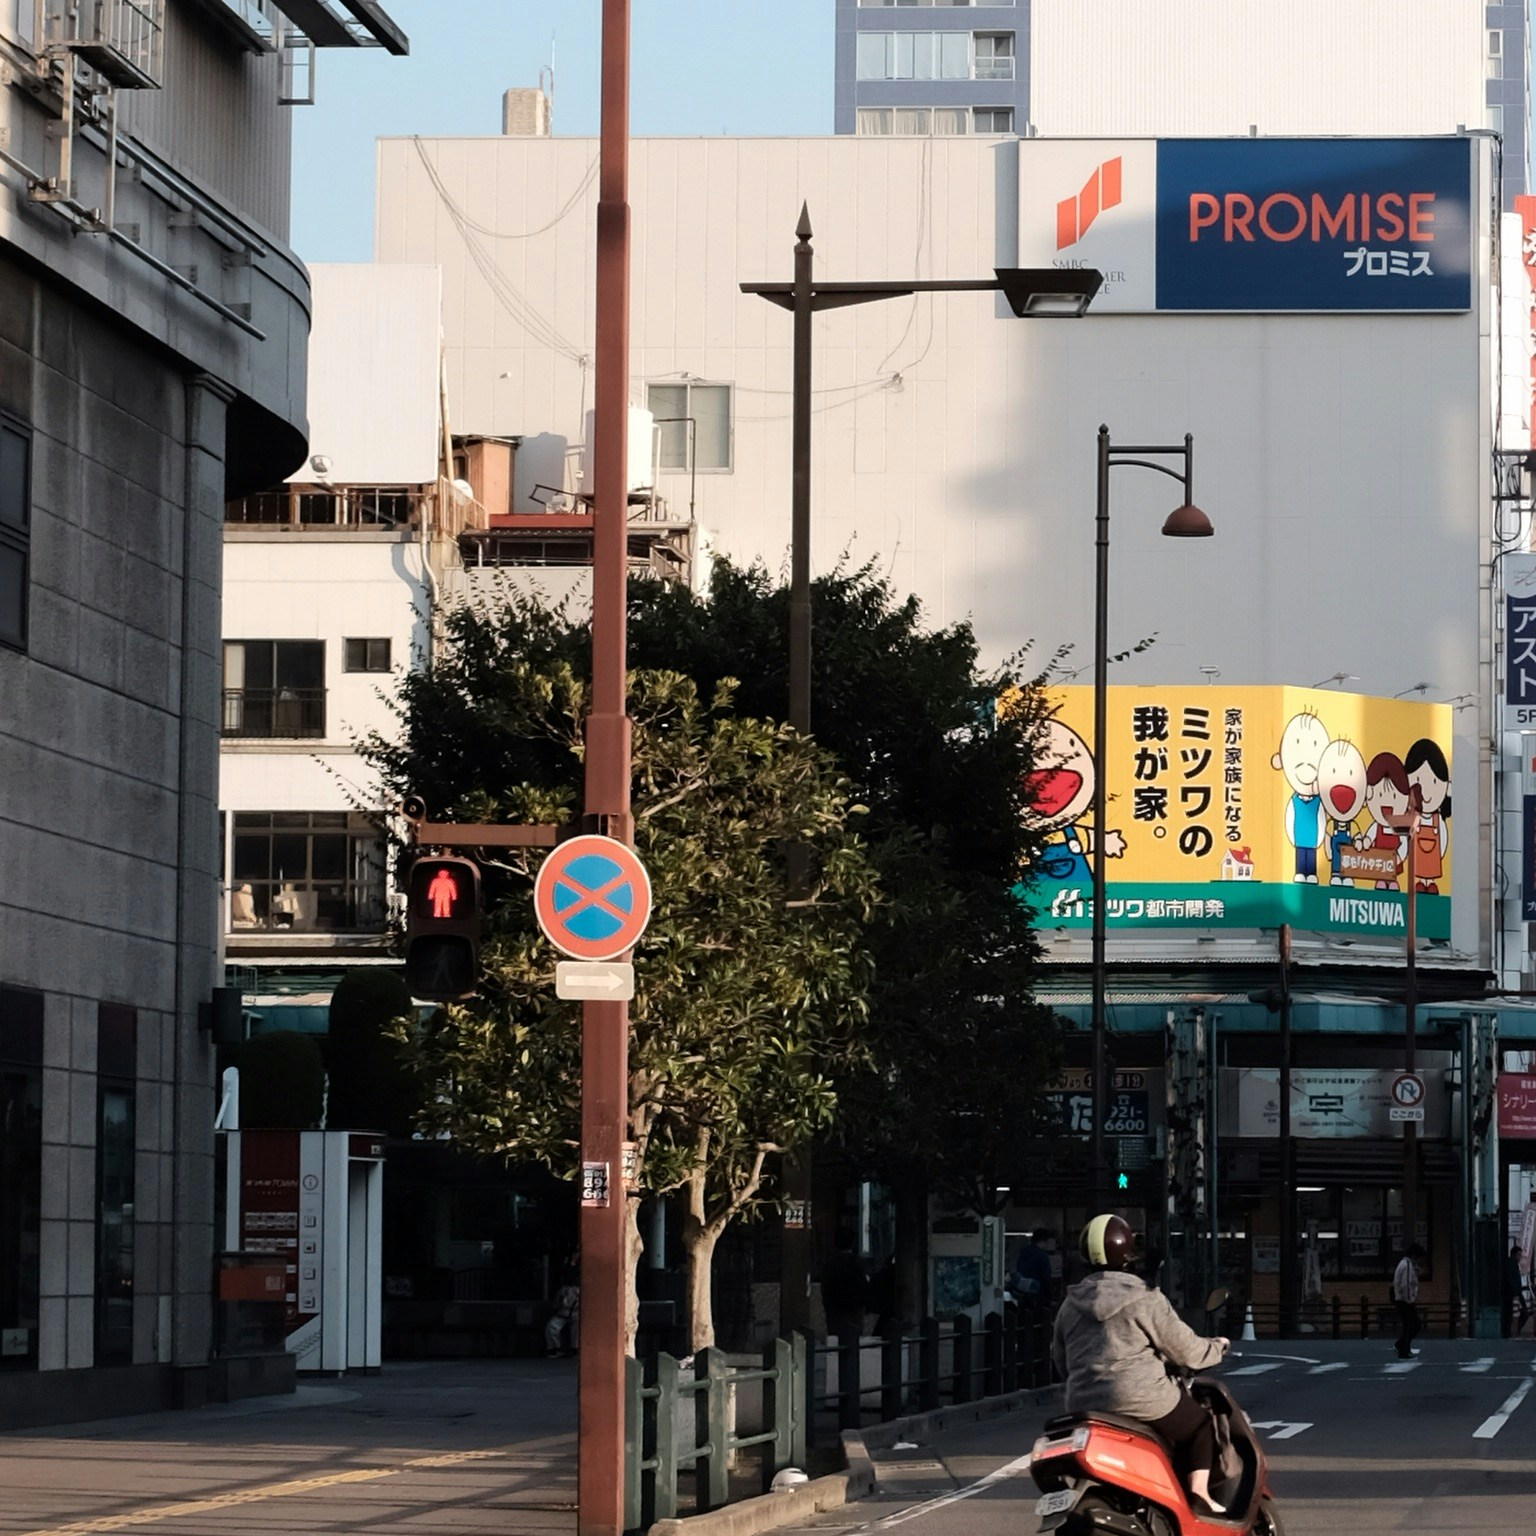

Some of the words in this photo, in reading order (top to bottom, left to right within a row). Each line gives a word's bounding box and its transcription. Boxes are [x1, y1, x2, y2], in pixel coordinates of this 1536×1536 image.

[1190, 192, 1436, 243] PROMISE
[1052, 258, 1089, 270] SMBC
[1343, 250, 1434, 277] プロミス
[1132, 705, 1170, 841] 我が家。
[1179, 705, 1214, 859] ミツワの
[1223, 707, 1243, 843] 家が家族になる
[1330, 897, 1405, 927] MITSUWA
[1103, 1119, 1146, 1133] 6600
[1391, 1110, 1423, 1119] ここから
